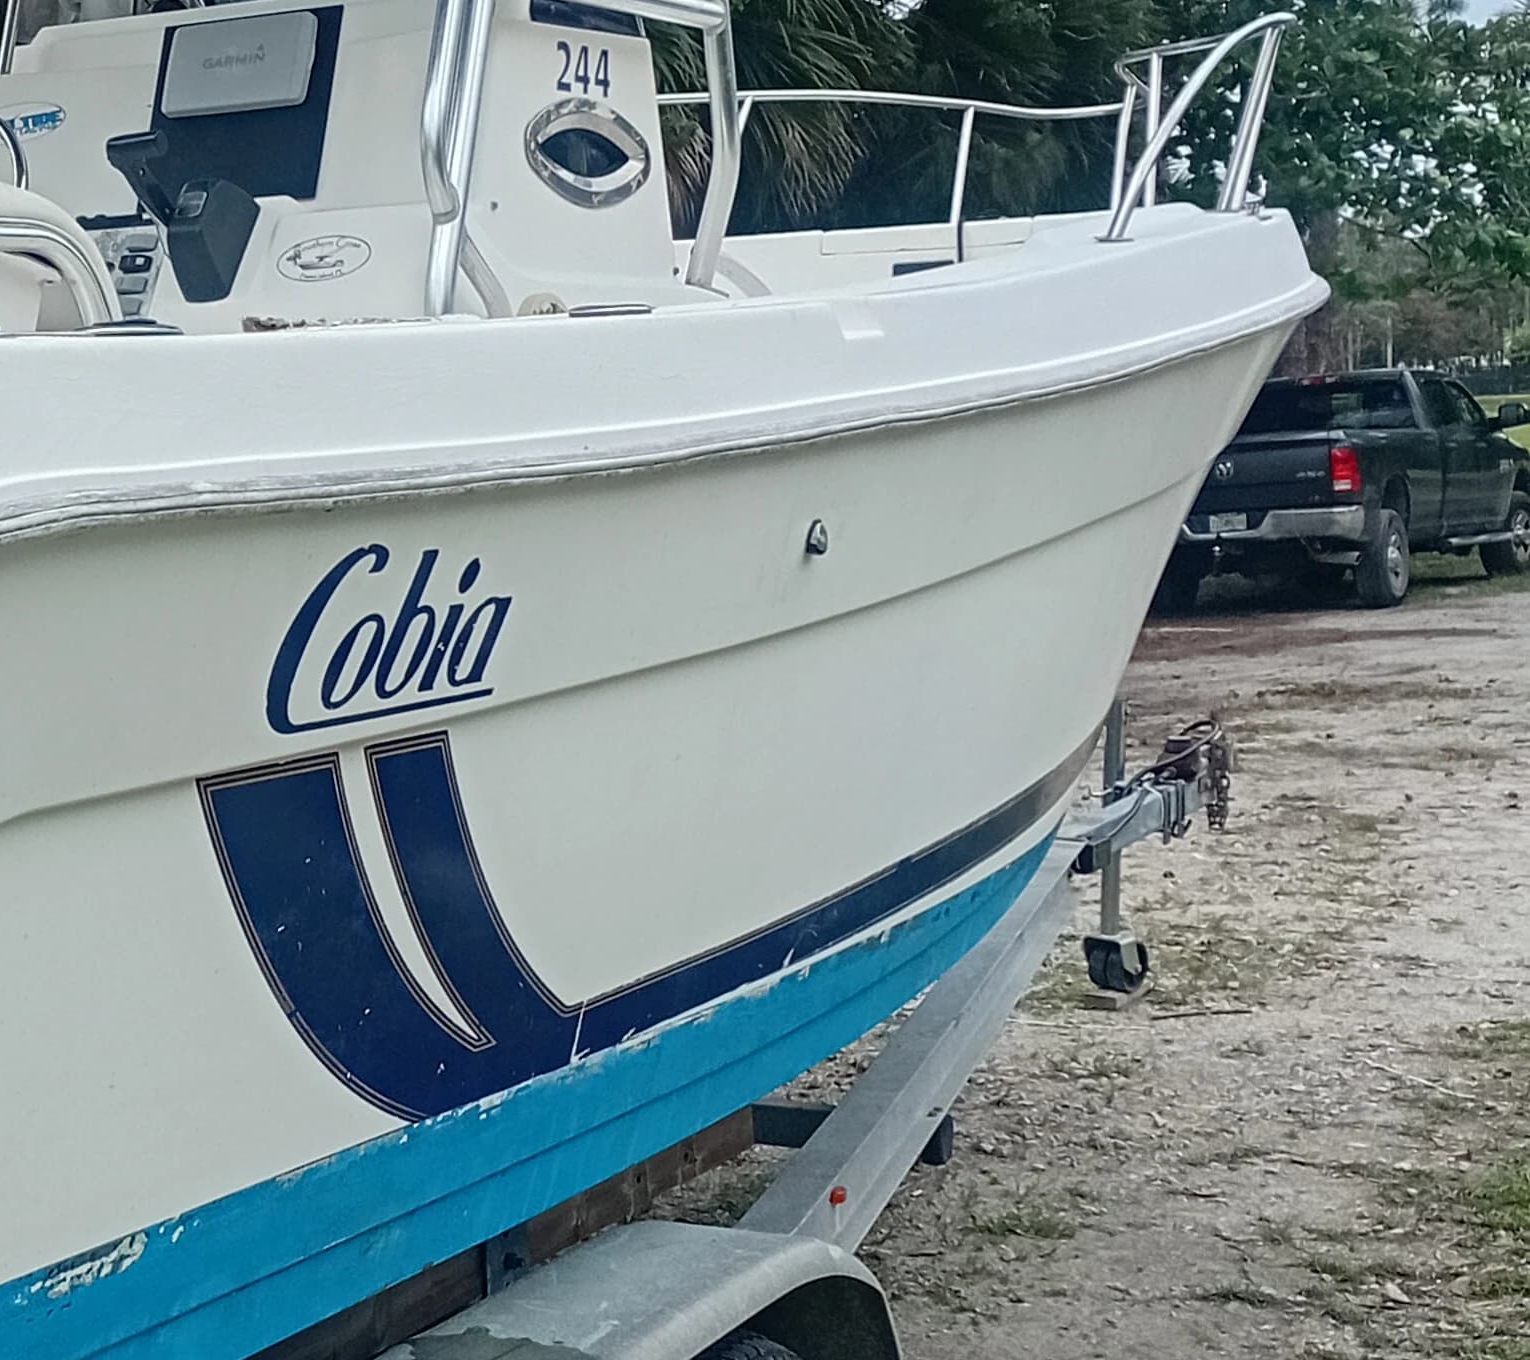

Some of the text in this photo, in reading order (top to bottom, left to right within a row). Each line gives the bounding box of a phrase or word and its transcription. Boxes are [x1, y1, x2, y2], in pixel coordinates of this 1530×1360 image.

[202, 47, 265, 70] GARMIN
[556, 40, 611, 98] 244
[266, 543, 512, 735] Cobia
